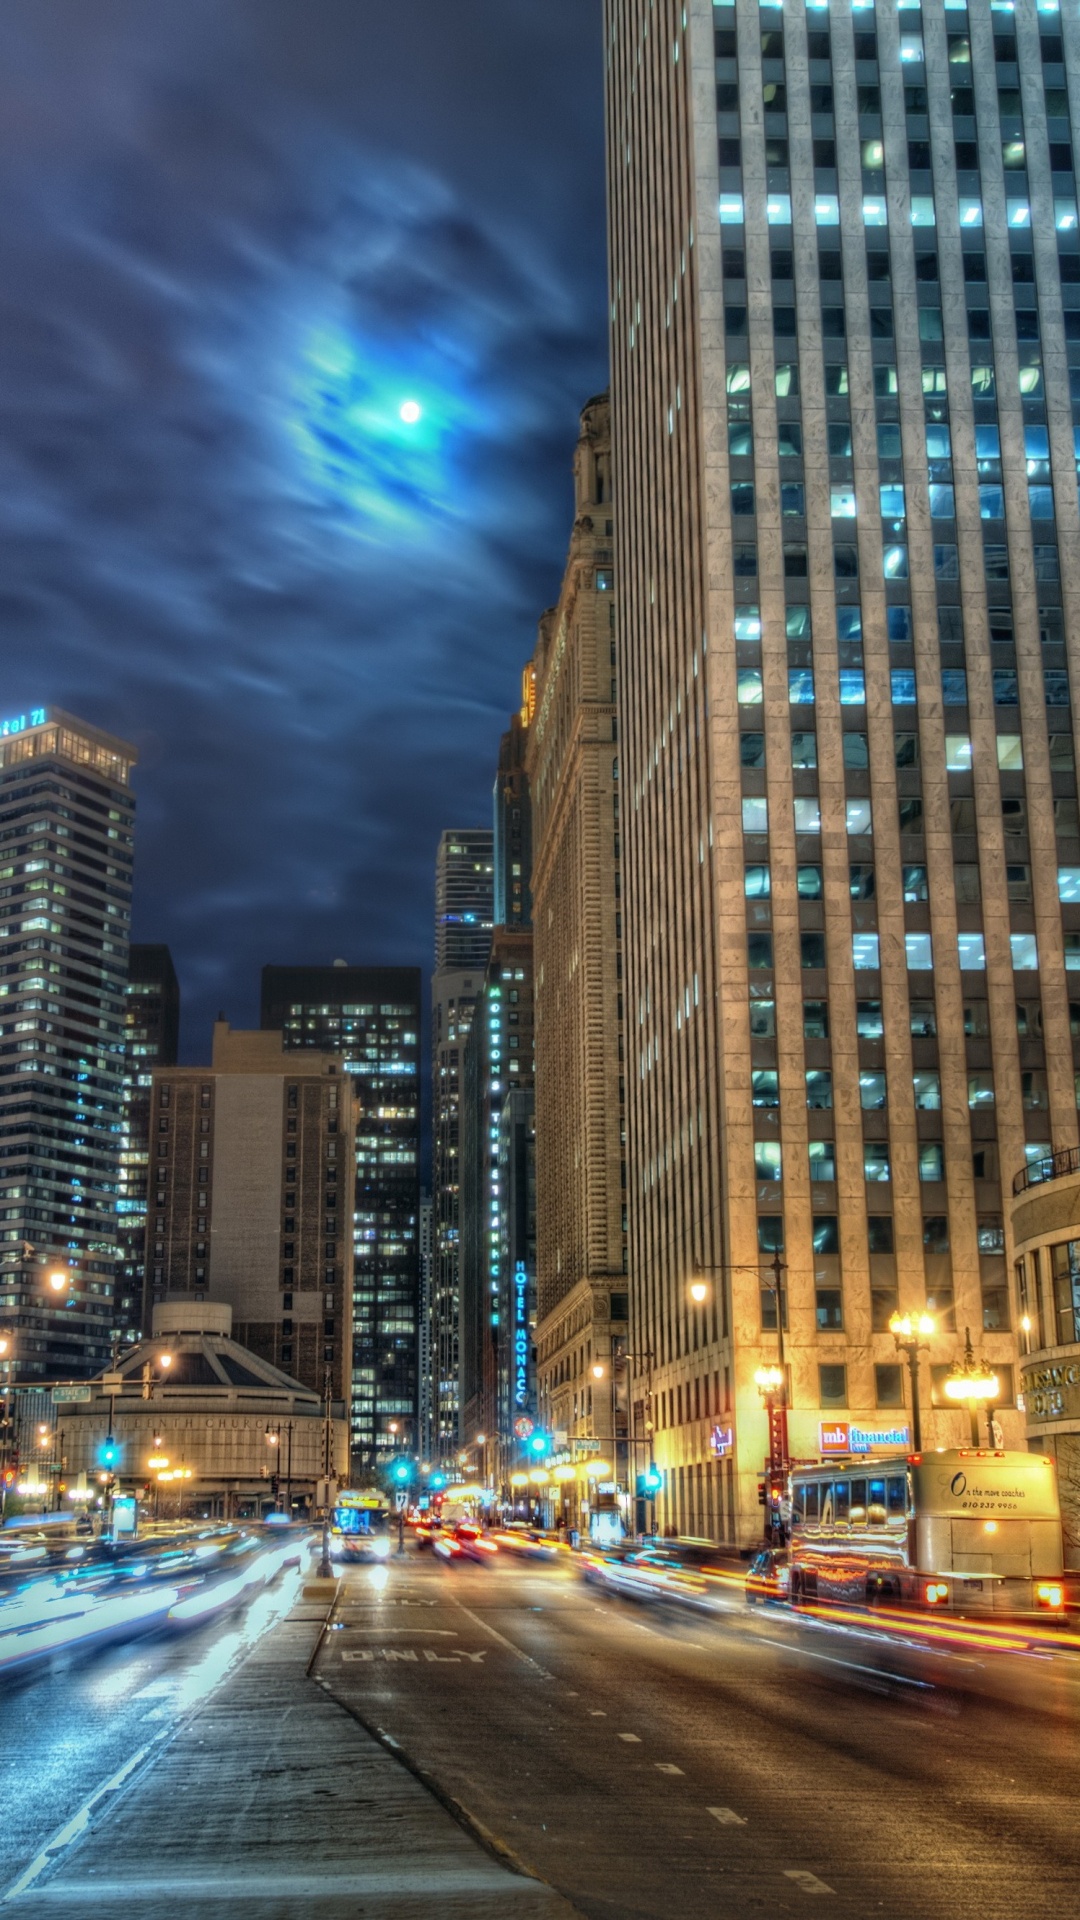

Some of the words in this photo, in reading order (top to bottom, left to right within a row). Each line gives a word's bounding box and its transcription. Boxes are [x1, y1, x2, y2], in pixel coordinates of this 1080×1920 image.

[0, 715, 26, 737] tel
[31, 709, 45, 727] 71
[491, 1112, 500, 1154] THE
[515, 1260, 527, 1322] HOTEL
[515, 1328, 527, 1403] MONACO
[70, 1418, 194, 1431] SEVENTEENTH
[205, 1418, 274, 1430] CHURCH
[823, 1427, 846, 1443] mb
[849, 1426, 909, 1444] financial
[972, 1486, 982, 1496] the
[1001, 1488, 1025, 1498] coaches
[341, 1650, 487, 1663] ONLY
